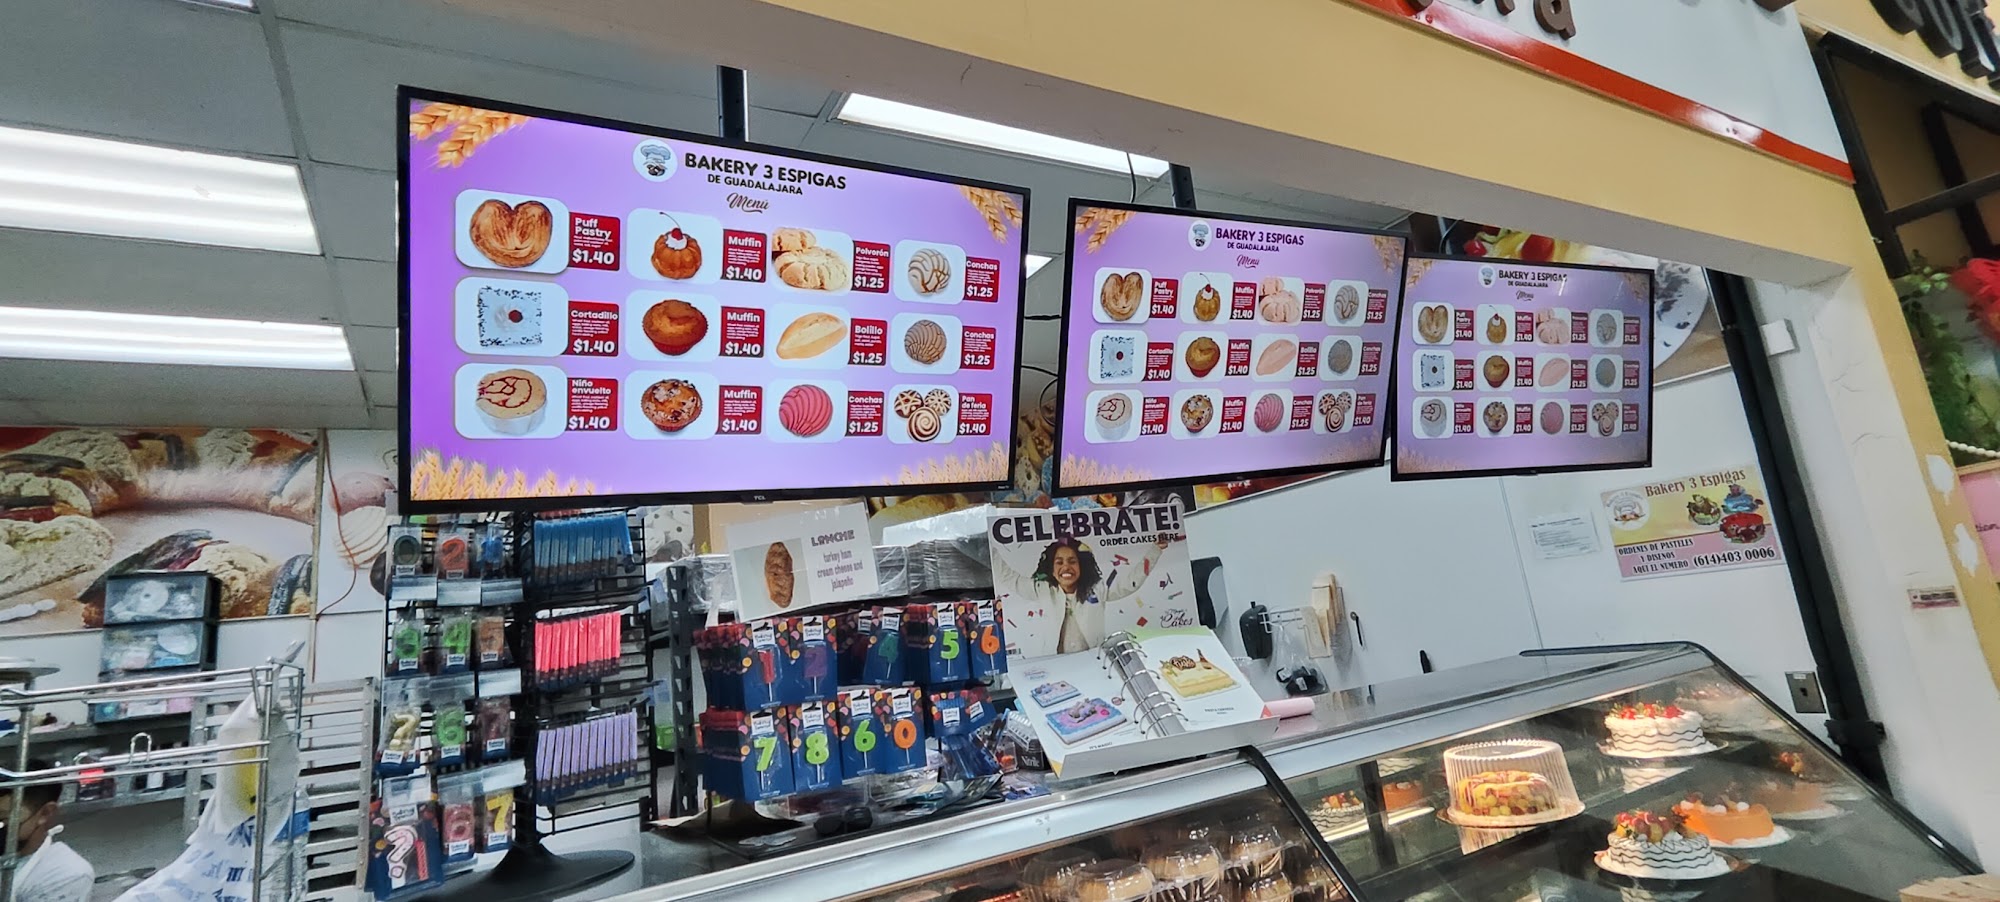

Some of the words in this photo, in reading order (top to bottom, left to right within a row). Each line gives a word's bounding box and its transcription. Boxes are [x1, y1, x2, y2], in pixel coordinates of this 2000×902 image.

[685, 153, 758, 176] BAKERY
[764, 165, 773, 178] 3
[778, 167, 846, 189] ESPIGAS
[708, 174, 721, 184] DE
[724, 176, 803, 195] GUADALAJARA
[575, 217, 598, 228] Puff
[575, 226, 611, 240] Pastry
[1216, 228, 1255, 241] BAKERY
[1258, 232, 1264, 242] 3
[1266, 232, 1304, 246] ESPIGAS
[728, 235, 761, 248] Muffin
[855, 246, 889, 258] Polvorón
[1236, 243, 1279, 252] GUADALAJARA
[572, 248, 614, 264] $1.40
[966, 260, 998, 271] Conchas
[726, 265, 762, 281] $1.40
[1499, 269, 1529, 281] BAKERY
[1531, 272, 1536, 280] 3
[854, 275, 885, 289] $1.25
[1155, 281, 1167, 289] Puff
[966, 286, 993, 298] $1.25
[1154, 288, 1174, 296] Pastry
[1235, 287, 1254, 295] Muffin
[571, 310, 618, 320] Cortadillo
[1151, 304, 1174, 315] $1.40
[1232, 308, 1253, 319] $1.40
[1303, 309, 1320, 319] $1.25
[727, 311, 760, 323] Muffin
[1367, 311, 1382, 320] $1.25
[854, 325, 883, 335] Bolillo
[964, 331, 994, 340] Conchas
[1455, 329, 1472, 338] $1.40
[1516, 333, 1532, 341] $1.40
[1572, 333, 1586, 341] $1.25
[573, 339, 615, 354] $1.40
[725, 341, 761, 355] $1.40
[1231, 342, 1249, 350] Muffin
[852, 352, 883, 364] $1.25
[964, 354, 990, 366] $1.25
[1228, 365, 1248, 375] $1.40
[1297, 366, 1315, 376] $1.25
[1361, 363, 1377, 373] $1.25
[1147, 369, 1170, 379] $1.40
[572, 379, 593, 388] Niño
[1456, 380, 1472, 389] $1.40
[1516, 378, 1532, 386] $1.40
[1572, 380, 1586, 388] $1.25
[572, 387, 611, 395] envuelto
[724, 389, 757, 400] Muffin
[849, 396, 883, 404] Conchas
[962, 395, 975, 403] Pan
[569, 416, 610, 430] $1.40
[722, 418, 758, 432] $1.40
[1222, 421, 1242, 431] $1.40
[1292, 418, 1309, 427] $1.25
[1355, 416, 1371, 425] $1.40
[849, 422, 878, 433] $1.25
[959, 424, 986, 434] $1.40
[1142, 424, 1164, 434] $1.40
[1455, 424, 1471, 432] $1.40
[1515, 424, 1531, 432] $1.40
[1645, 481, 1686, 498] Bakery
[1689, 477, 1697, 489] 3
[1699, 470, 1746, 488] Espigas
[992, 505, 1180, 544] CELEBRATE!
[1100, 537, 1129, 547] ORDER
[1130, 535, 1157, 544] CAKES
[1158, 533, 1179, 543] HERE
[1618, 545, 1649, 555] ORDENES
[1650, 543, 1659, 551] DE
[1660, 538, 1694, 550] PASTELES
[823, 551, 840, 564] turkey
[1693, 551, 1742, 567] (614)403
[1745, 547, 1775, 561] 0006
[817, 568, 834, 579] cream
[853, 561, 863, 571] and
[1650, 563, 1659, 572] EL
[940, 629, 960, 660] 5
[981, 624, 1000, 655] 6
[854, 719, 876, 752] 6
[894, 719, 917, 749] 0
[753, 736, 777, 771] 7
[806, 732, 829, 765] 8
[486, 792, 513, 833] 7
